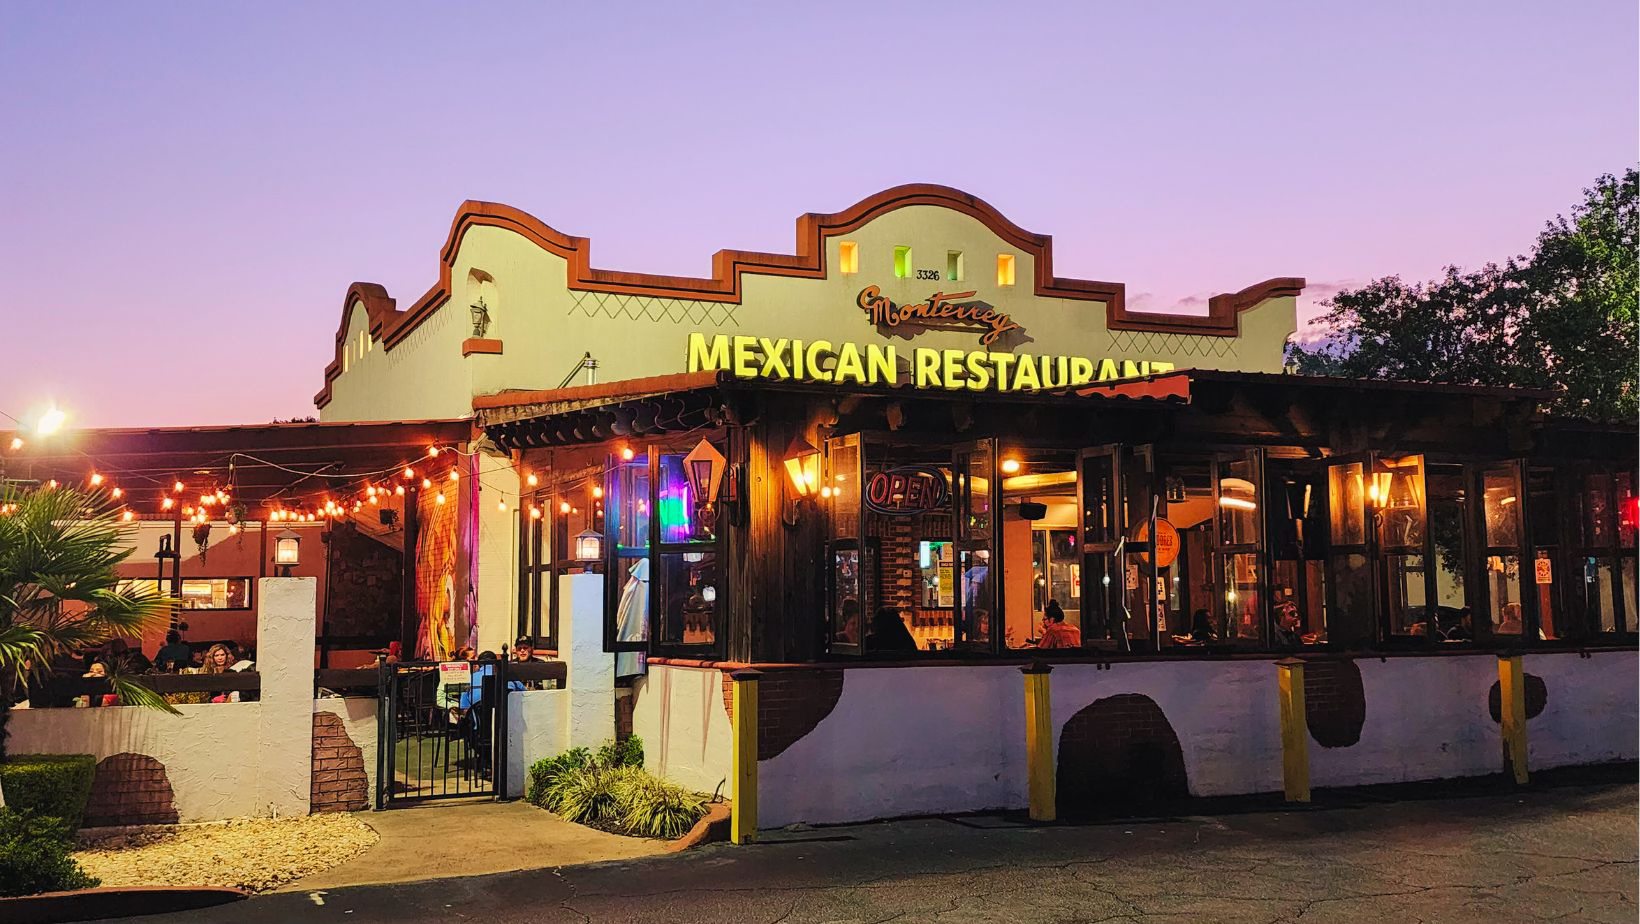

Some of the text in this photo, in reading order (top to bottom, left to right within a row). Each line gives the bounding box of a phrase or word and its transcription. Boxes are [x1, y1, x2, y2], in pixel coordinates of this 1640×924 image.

[916, 269, 940, 281] 3326
[858, 284, 1021, 346] Monterrey
[687, 332, 898, 384] MEXICAN
[870, 473, 940, 509] OPEN
